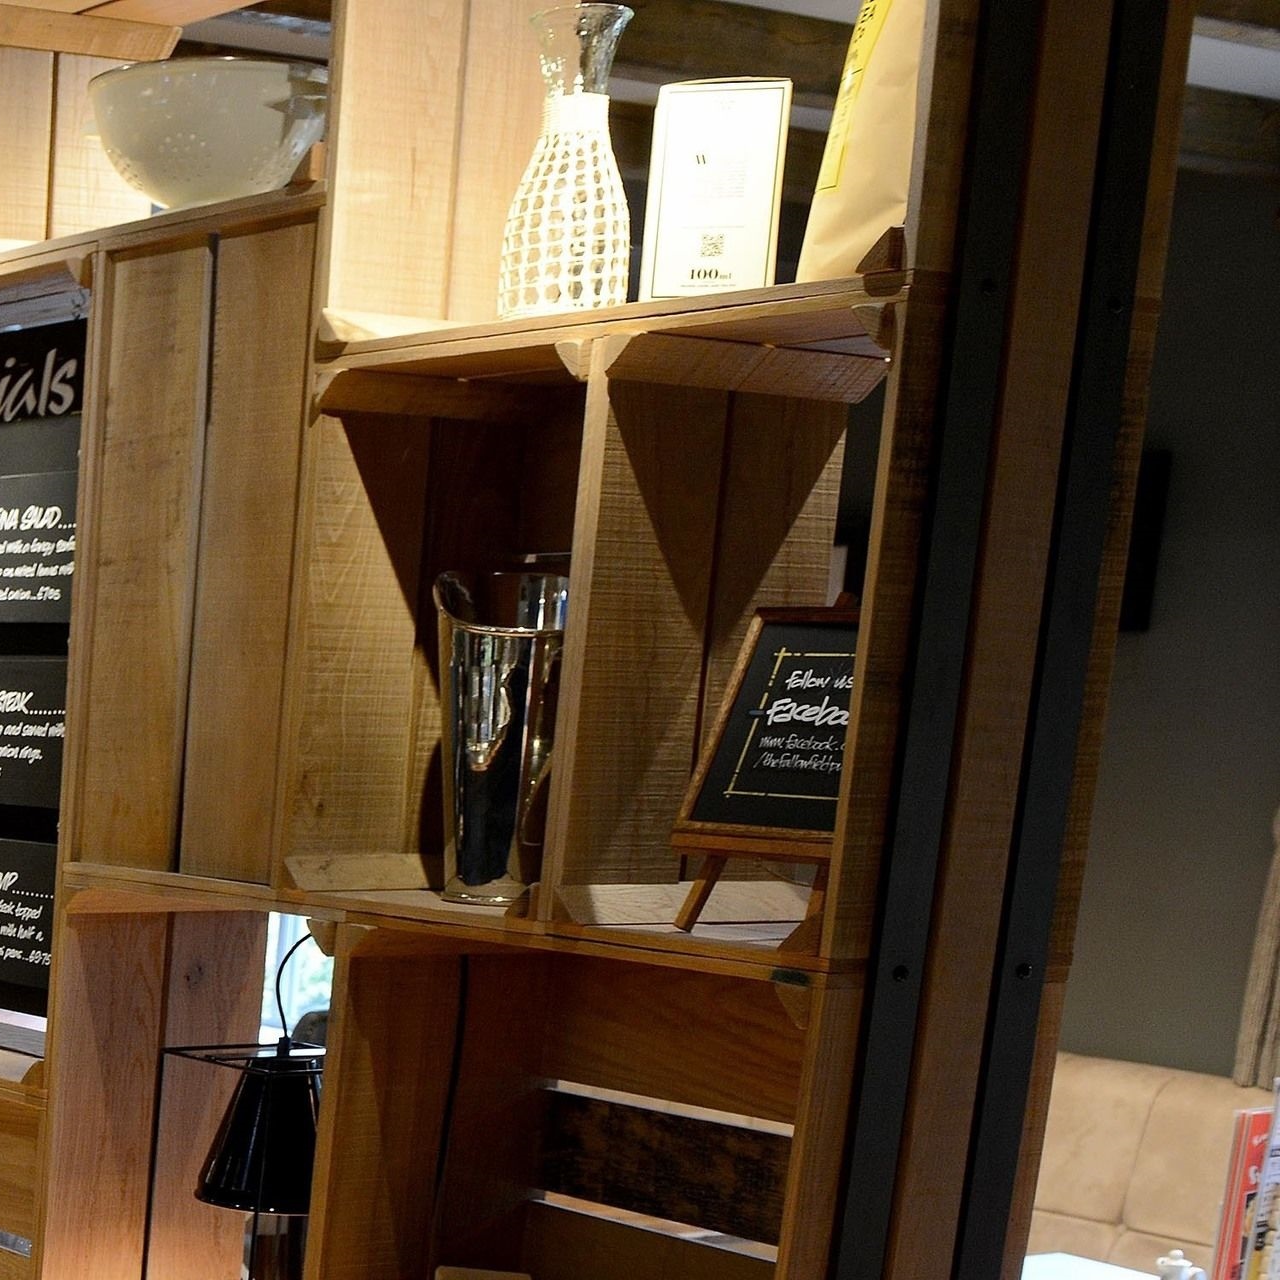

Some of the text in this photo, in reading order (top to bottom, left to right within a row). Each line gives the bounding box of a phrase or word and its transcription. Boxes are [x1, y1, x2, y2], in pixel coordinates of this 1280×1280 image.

[785, 669, 854, 690] Follow us
[4, 722, 23, 735] and
[15, 903, 43, 920] topped
